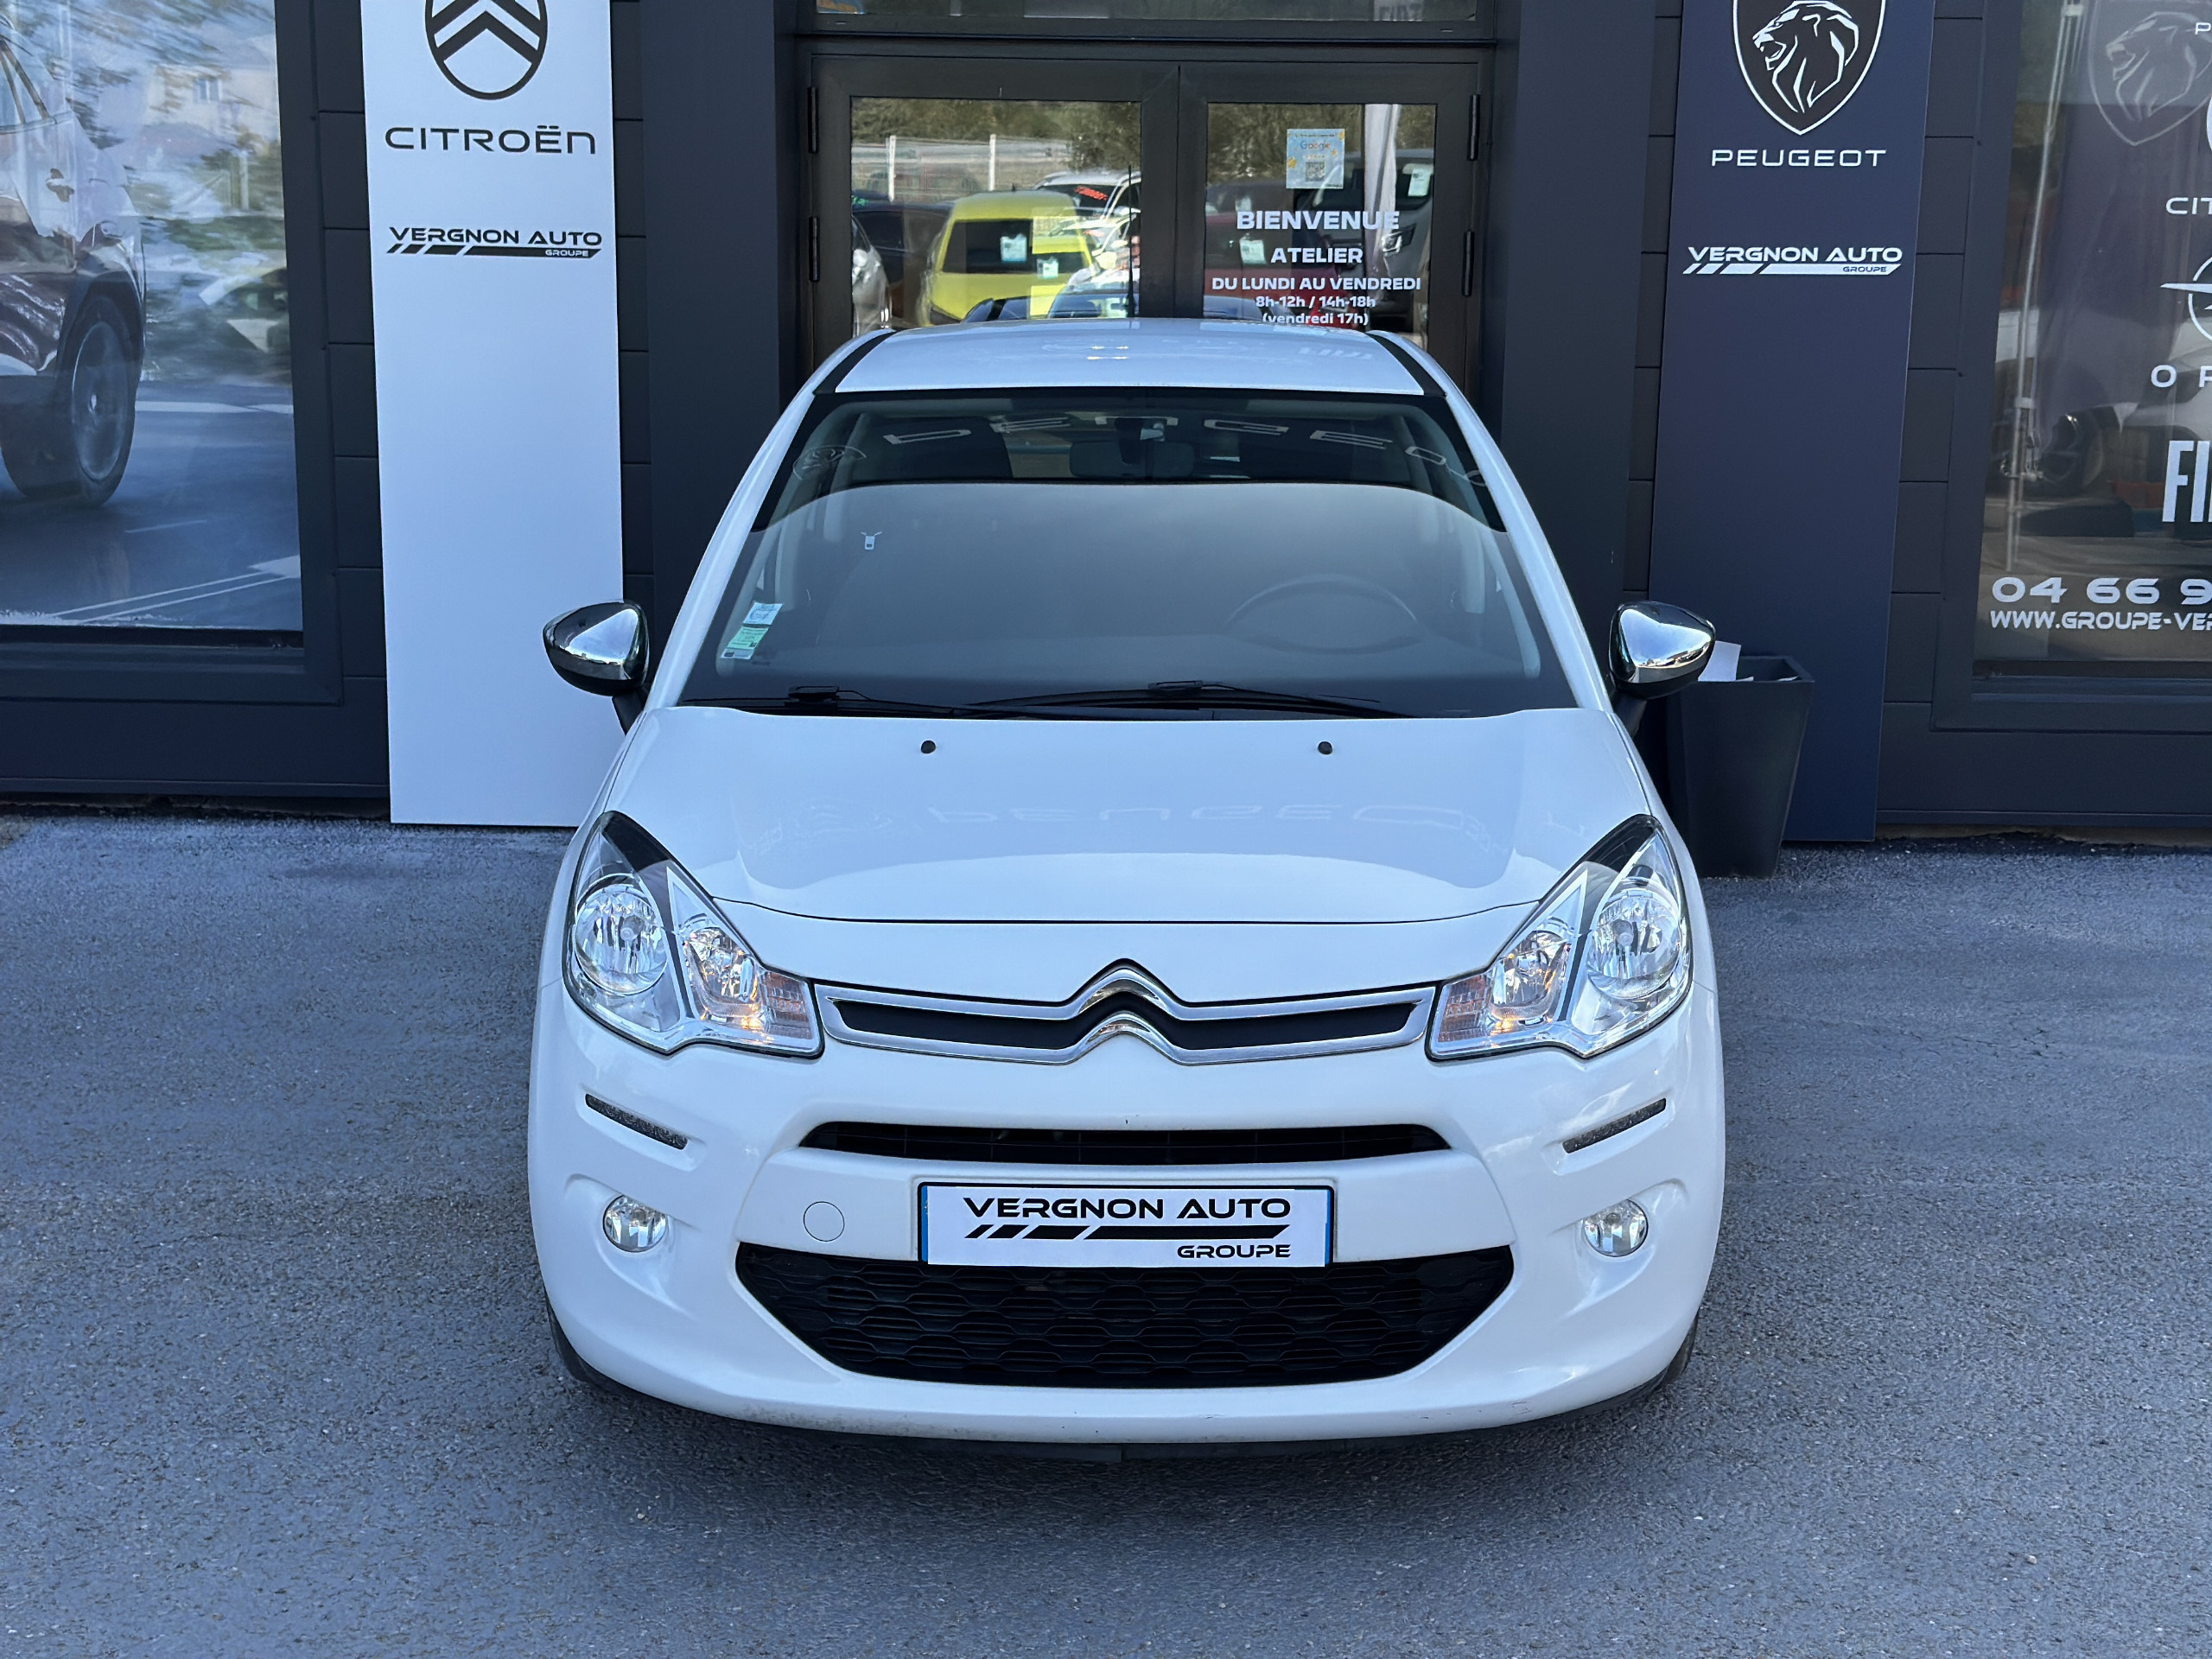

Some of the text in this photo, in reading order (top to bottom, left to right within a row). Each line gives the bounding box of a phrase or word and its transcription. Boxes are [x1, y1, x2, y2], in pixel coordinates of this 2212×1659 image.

[1711, 149, 1887, 167] PEUGEOT
[1236, 210, 1400, 231] BIENVENUE
[389, 226, 602, 246] VERGNON AUTO
[544, 249, 589, 257] GROUPE
[1270, 247, 1363, 264] ATELIER
[1688, 246, 1903, 263] VERGNON AUTO
[1211, 277, 1421, 290] DU LUNDI AU VENDREDI
[1255, 296, 1306, 308] 8h-12h
[1319, 296, 1376, 308] 14h-18h
[1262, 312, 1369, 326] (vendredi 17h)
[2162, 440, 2212, 523] FI
[1992, 577, 2212, 605] 04 66 9
[963, 1197, 1291, 1219] VERGNON AUTO
[1177, 1244, 1291, 1259] GROUPE
